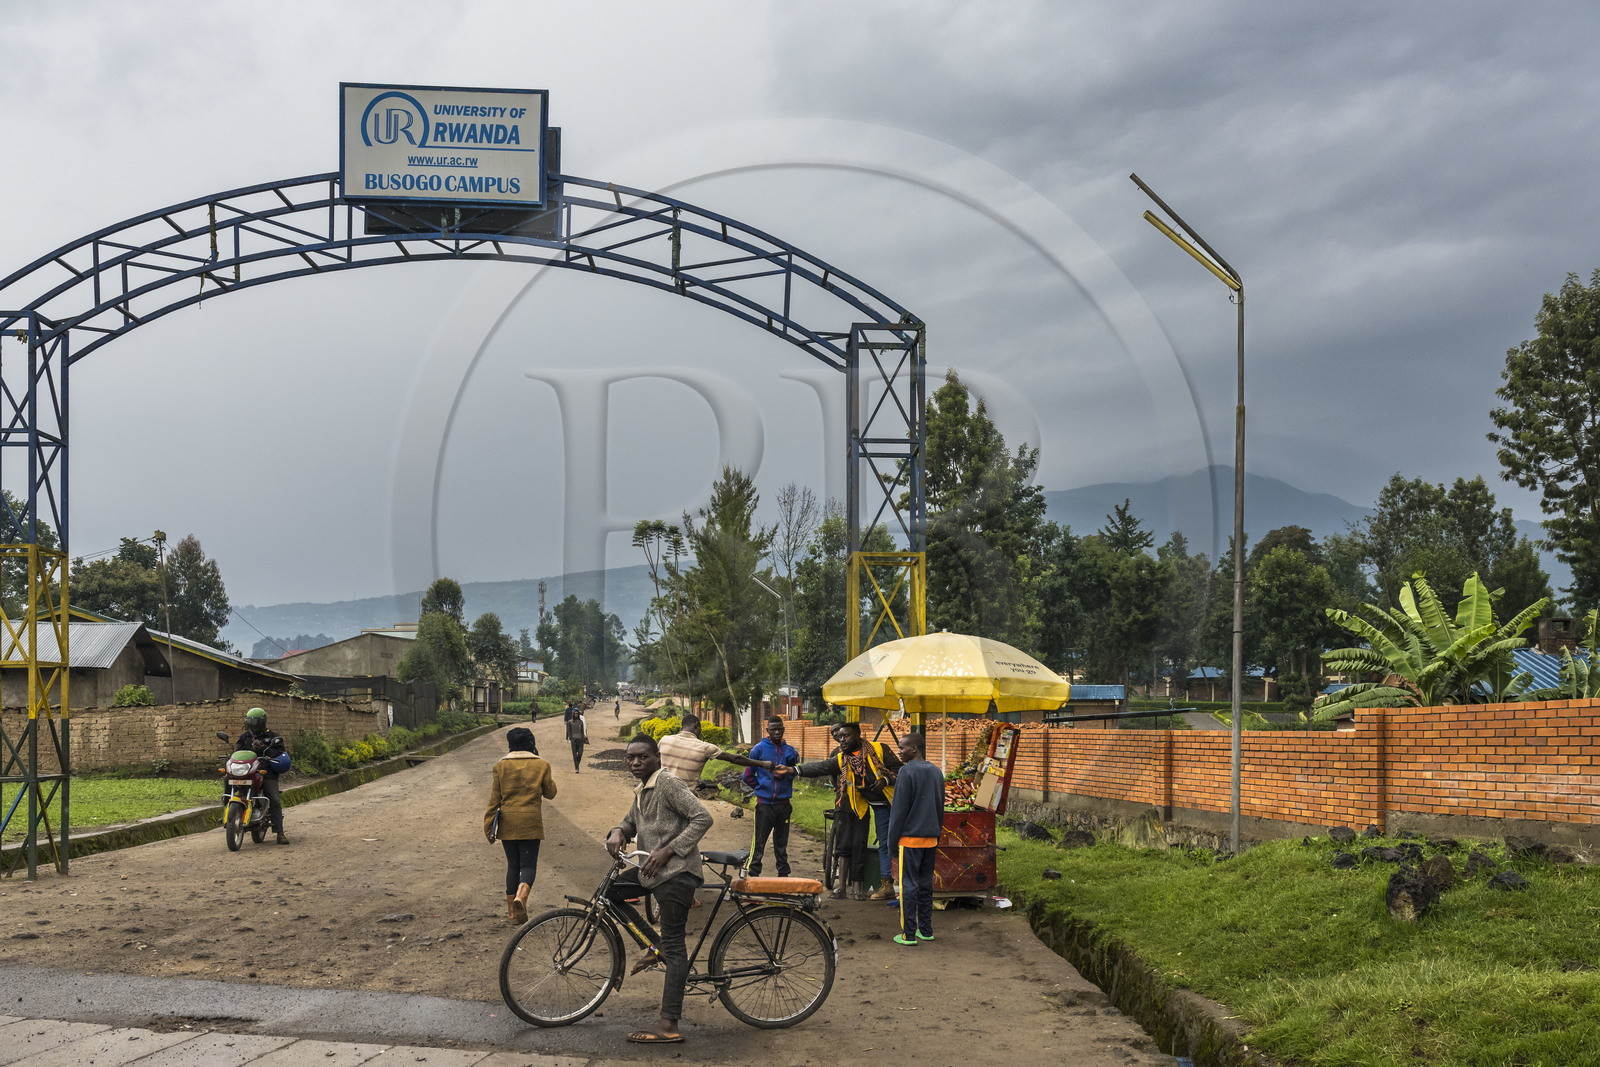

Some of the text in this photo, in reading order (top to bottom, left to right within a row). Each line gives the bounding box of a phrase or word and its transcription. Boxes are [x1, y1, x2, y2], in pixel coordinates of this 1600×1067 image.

[433, 104, 527, 119] UNIVERSITY OF
[433, 122, 521, 145] RWANDA
[407, 155, 479, 167] www.ur.ac.rw
[364, 173, 521, 194] BUSOGO CAMPUS
[995, 660, 1040, 670] everywhere
